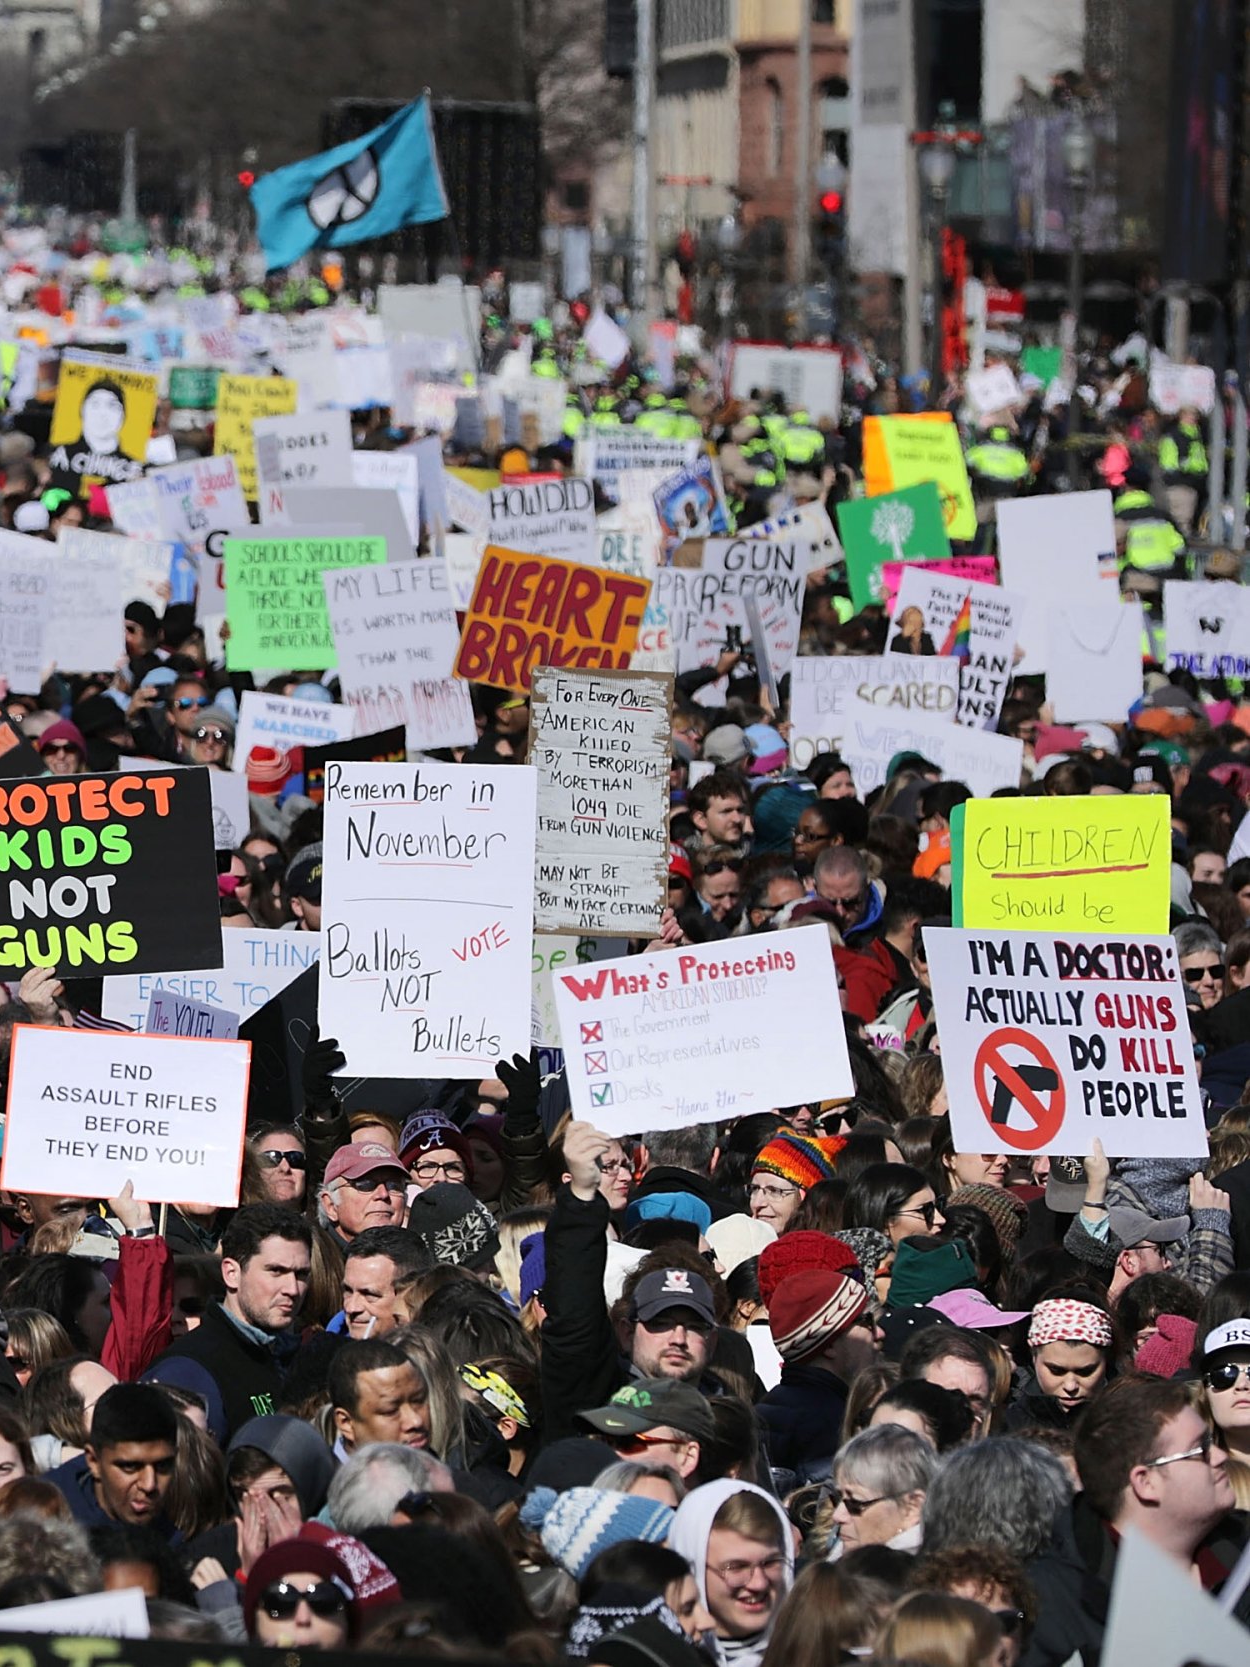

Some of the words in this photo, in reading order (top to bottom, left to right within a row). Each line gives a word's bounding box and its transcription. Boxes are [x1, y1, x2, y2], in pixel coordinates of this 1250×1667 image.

[490, 484, 543, 519] HOW
[545, 478, 594, 512] DID
[241, 542, 303, 565] SCHOOLS
[358, 540, 379, 564] BE
[723, 540, 797, 572] GUN
[333, 573, 363, 603] MY
[374, 565, 448, 597] LIFE
[699, 573, 802, 618] REFORM
[363, 612, 416, 632] WORTH
[355, 651, 397, 670] THAN
[404, 647, 434, 663] THE
[266, 702, 290, 717] WE
[290, 705, 332, 721] HAVE
[619, 688, 652, 708] ONE
[815, 684, 846, 715] BE
[855, 680, 957, 713] SCARED
[252, 717, 339, 740] MARCHED
[540, 706, 635, 735] AMERICAN
[544, 750, 562, 767] BY
[572, 750, 658, 777] TERRORISM
[326, 762, 454, 803] Remember
[470, 779, 495, 805] in
[571, 794, 607, 818] 1049
[616, 801, 643, 818] DIE
[346, 809, 509, 862] November
[570, 816, 602, 836] GUN
[605, 825, 665, 844] VIOLENCE
[976, 818, 1162, 871] CHILDREN
[539, 864, 565, 882] MAY
[568, 864, 592, 881] NOT
[601, 863, 620, 880] BE
[7, 872, 118, 921] NOT
[538, 893, 560, 909] BUT
[563, 896, 579, 912] MY
[569, 882, 631, 899] STRAIGHT
[578, 913, 605, 928] ARE
[1083, 891, 1118, 924] be
[326, 921, 423, 980] Ballots
[451, 920, 512, 963] VOTE
[967, 938, 1015, 977] I'M
[1022, 941, 1049, 978] A
[560, 962, 670, 1003] What's
[678, 947, 797, 986] Protecting
[232, 980, 272, 1008] TO
[379, 969, 444, 1014] NOT
[640, 988, 711, 1015] AMERICAN
[710, 976, 768, 1003] STUDENTS?
[174, 1001, 215, 1039] YOUTH
[605, 1017, 632, 1040] The
[632, 1009, 712, 1038] Government
[964, 986, 1085, 1028] ACTUALLY
[1093, 992, 1178, 1032] GUNS
[411, 1014, 502, 1058] Bullets
[611, 1046, 638, 1071] Our
[637, 1034, 761, 1068] Representatives
[1067, 1033, 1108, 1073] DO
[1118, 1037, 1186, 1076] KILL
[109, 1063, 153, 1082] END
[40, 1085, 139, 1108] ASSAULT
[144, 1091, 218, 1114] RIFLES
[615, 1079, 665, 1105] Desks
[1081, 1080, 1188, 1119] PEOPLE
[84, 1115, 171, 1137] BEFORE
[45, 1138, 100, 1159] THEY
[105, 1143, 149, 1163] END
[155, 1147, 207, 1167] YOU!
